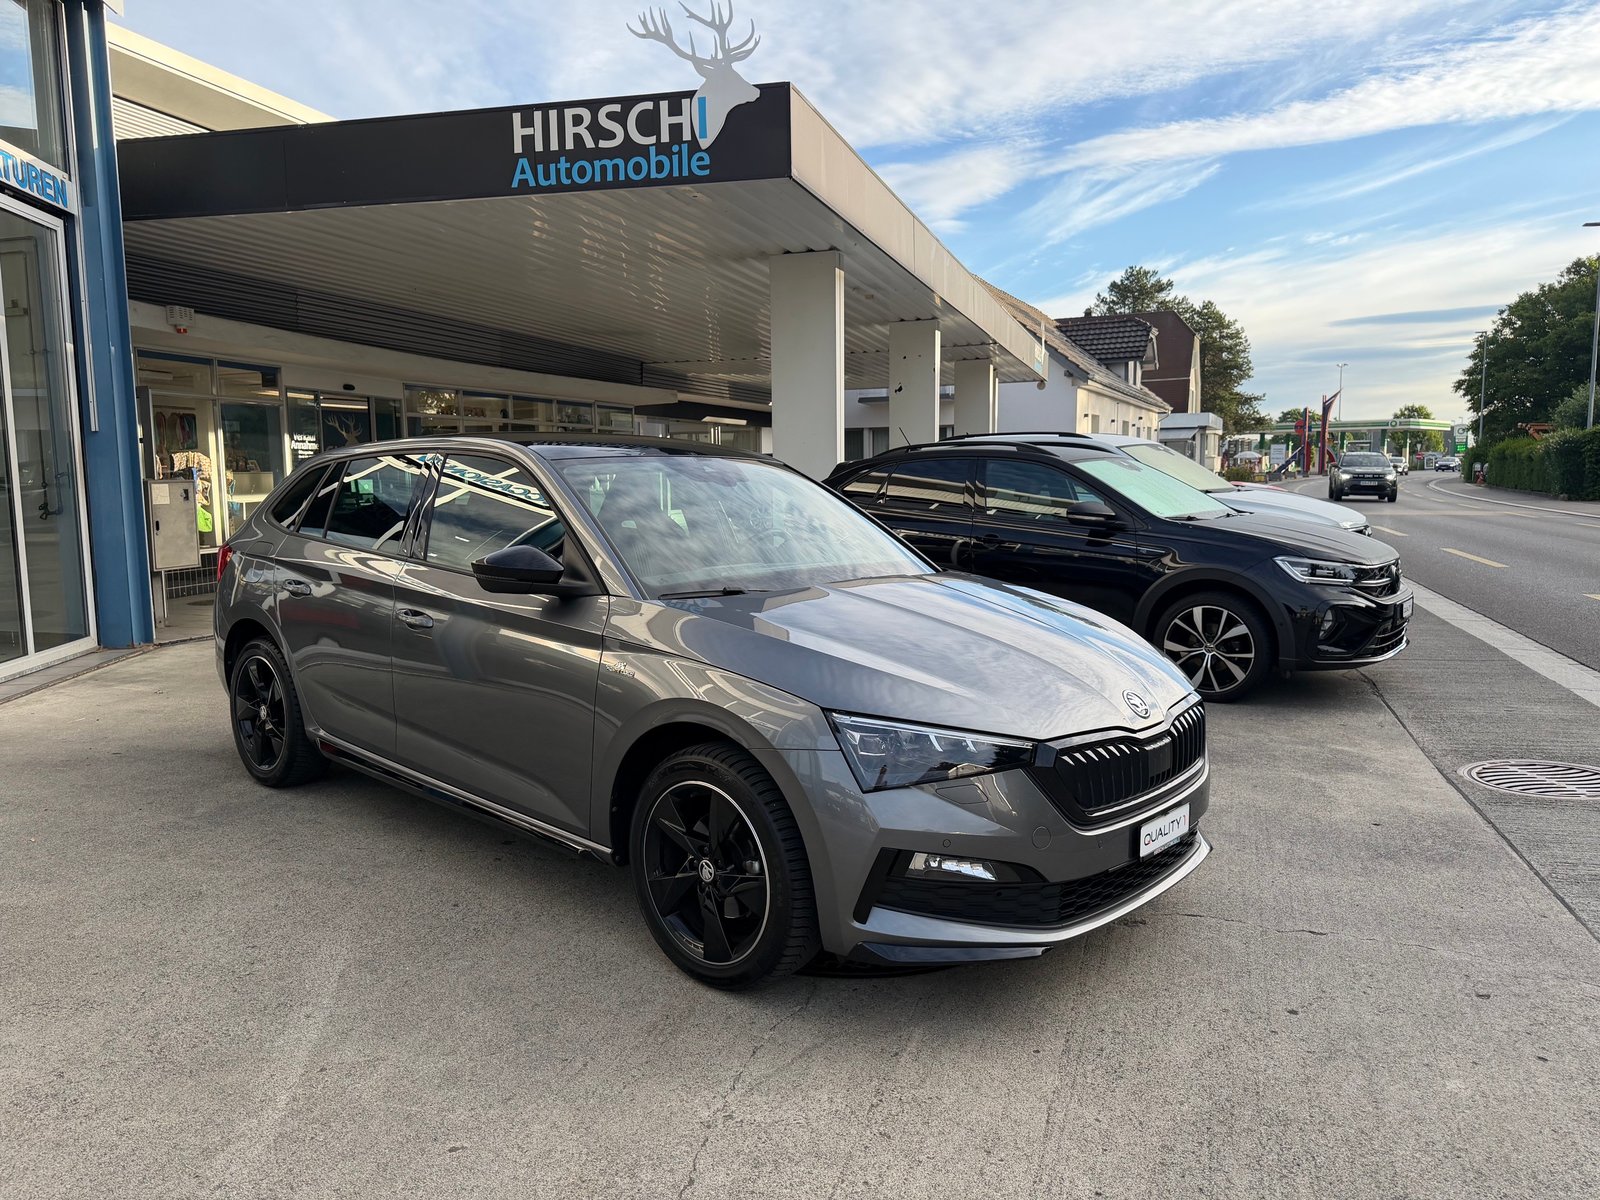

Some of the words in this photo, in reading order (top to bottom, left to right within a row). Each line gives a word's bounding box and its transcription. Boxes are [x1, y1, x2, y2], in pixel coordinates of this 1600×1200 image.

[0, 150, 68, 208] TUREN
[511, 143, 710, 188] Automobile
[1143, 816, 1182, 846] QUALITY
